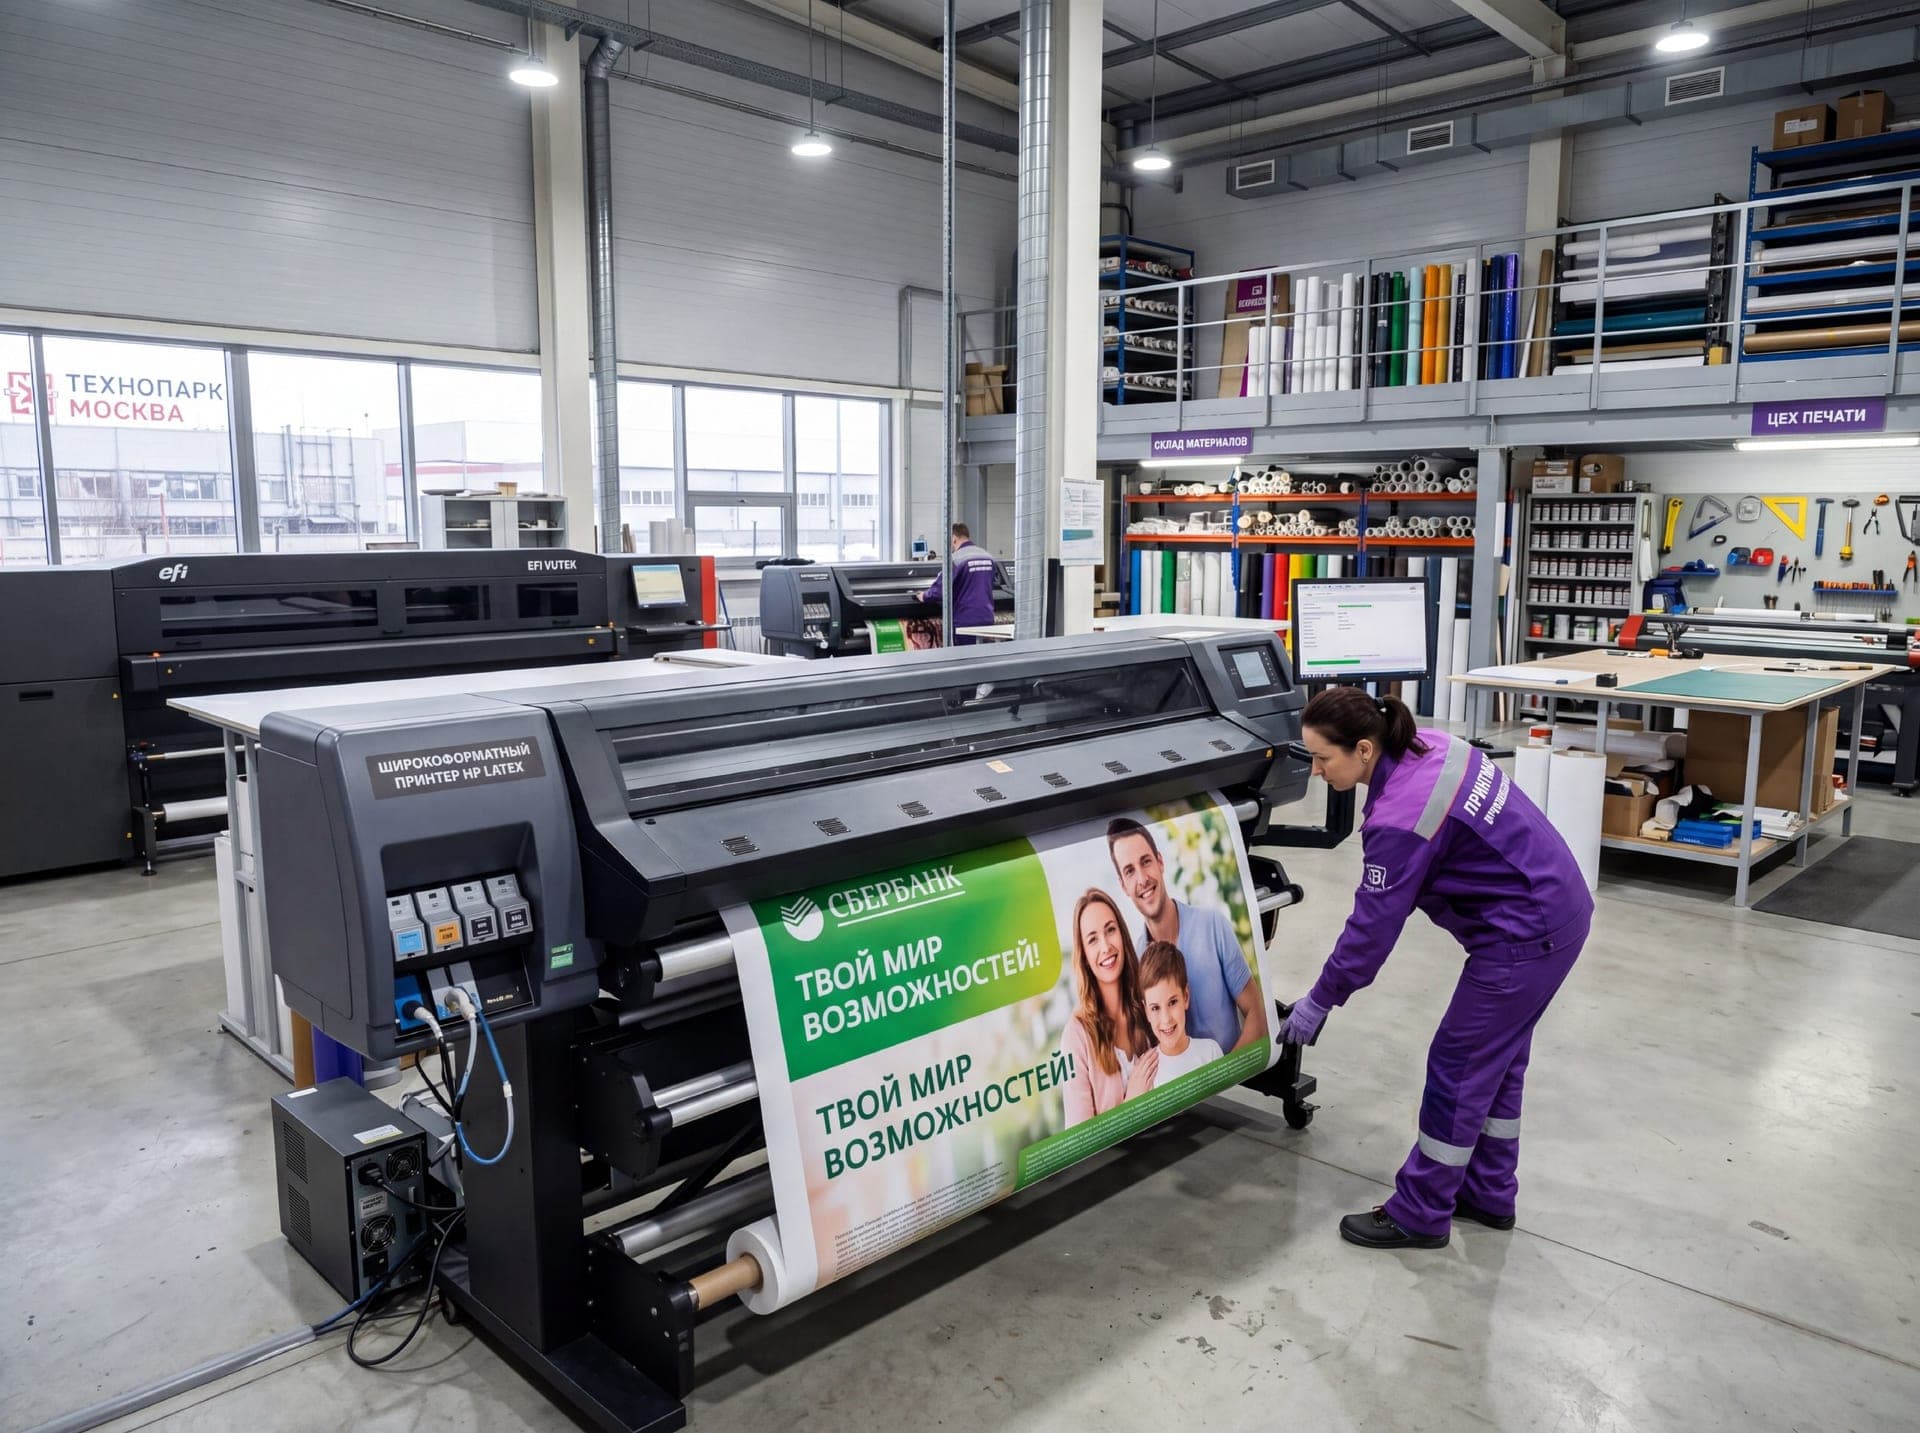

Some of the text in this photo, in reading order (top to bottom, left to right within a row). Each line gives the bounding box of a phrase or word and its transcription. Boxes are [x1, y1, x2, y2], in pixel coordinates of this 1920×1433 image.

[65, 373, 223, 401] ТЕХНОПАРК
[69, 399, 184, 422] МОСКВА
[1767, 408, 1866, 428] ЦЕХ ПЕЧАТИ
[1154, 436, 1248, 451] СКЛАД МАТЕРИАЛОВ
[158, 563, 189, 583] efi
[527, 559, 577, 571] EFI VUTEK
[377, 741, 531, 774] ШИРОКОФОРМАТНЫЙ
[394, 761, 525, 789] ПРИНТЕР HP LATEX
[827, 865, 963, 918] СБЕРБАНК
[794, 935, 943, 1001] ТВОЙ МИР
[802, 938, 1041, 1042] ВОЗМОЖНОСТЕЙ!
[815, 1054, 972, 1135] ТВОЙ МИР
[824, 1050, 1076, 1180] ВОЗМОЖНОСТЕЙ!
